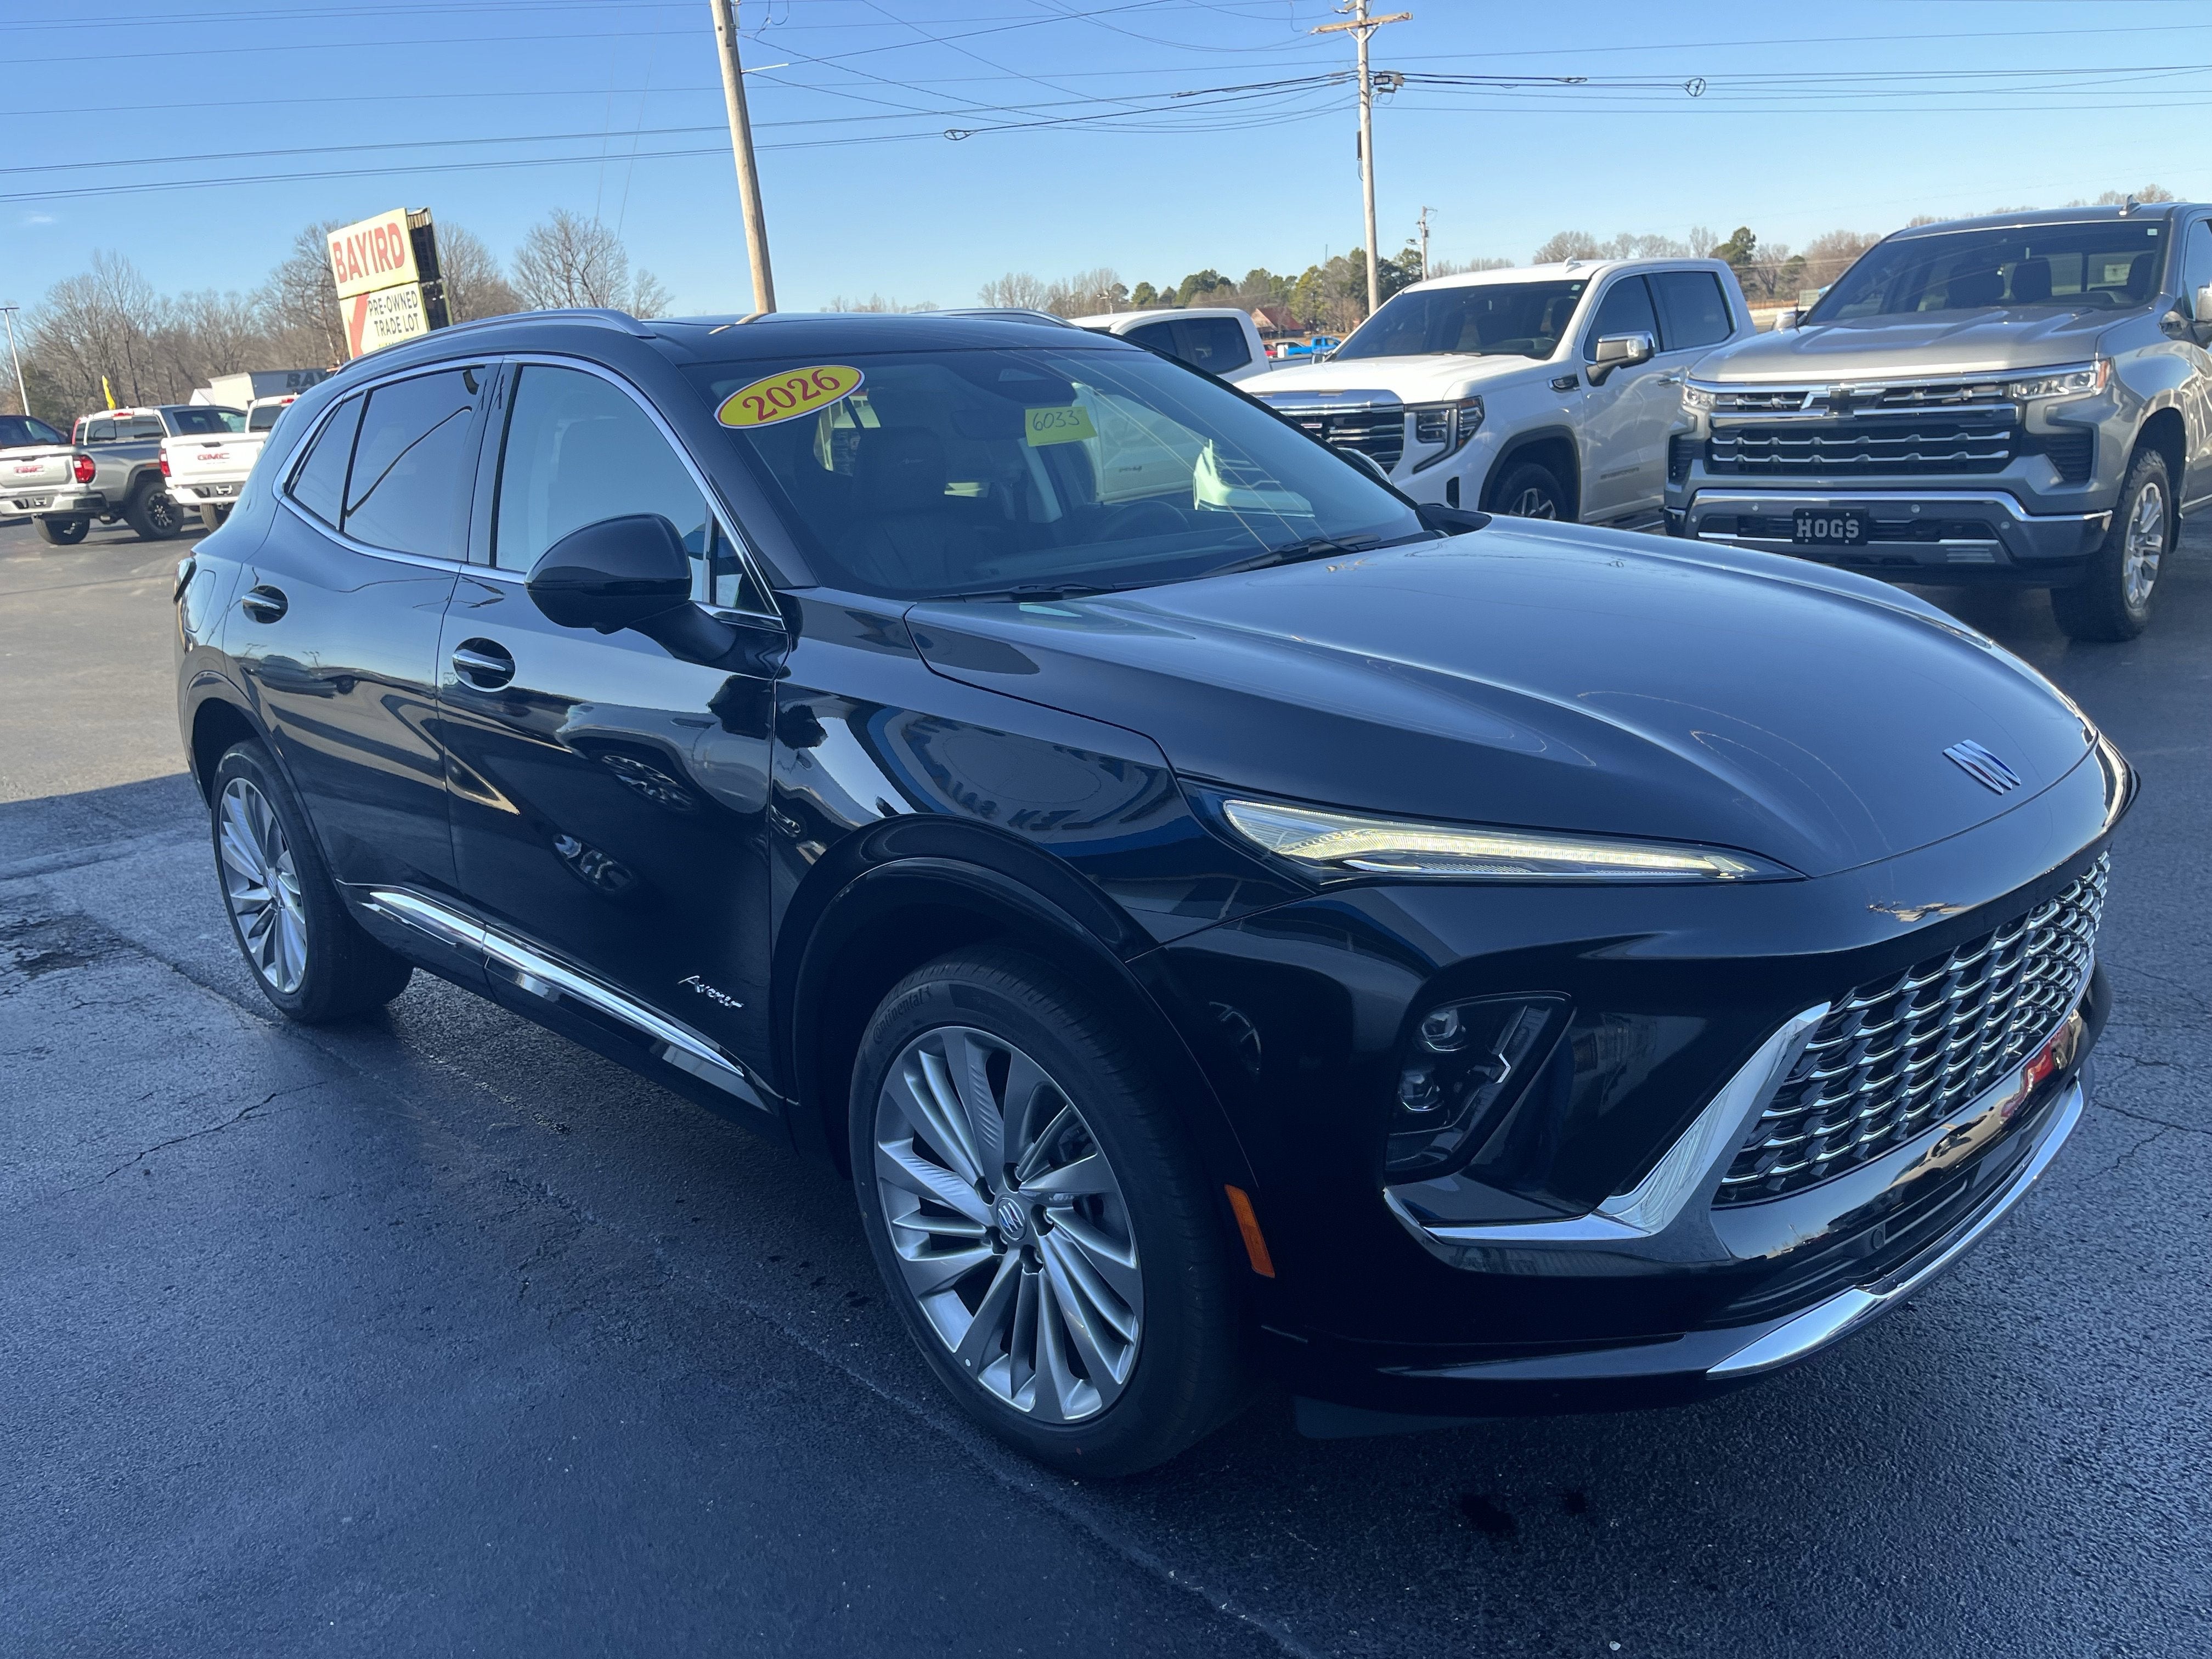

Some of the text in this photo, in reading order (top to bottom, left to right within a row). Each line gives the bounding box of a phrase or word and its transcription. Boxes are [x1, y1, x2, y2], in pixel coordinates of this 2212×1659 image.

[332, 223, 405, 284] BAYIRD
[368, 291, 417, 317] PRE-OWNED
[374, 313, 419, 336] TRADE LOT
[742, 369, 840, 421] 2026
[1033, 410, 1080, 431] 6033
[198, 452, 230, 460] GMC
[1796, 518, 1859, 538] HOGS
[873, 988, 925, 1045] Continental
